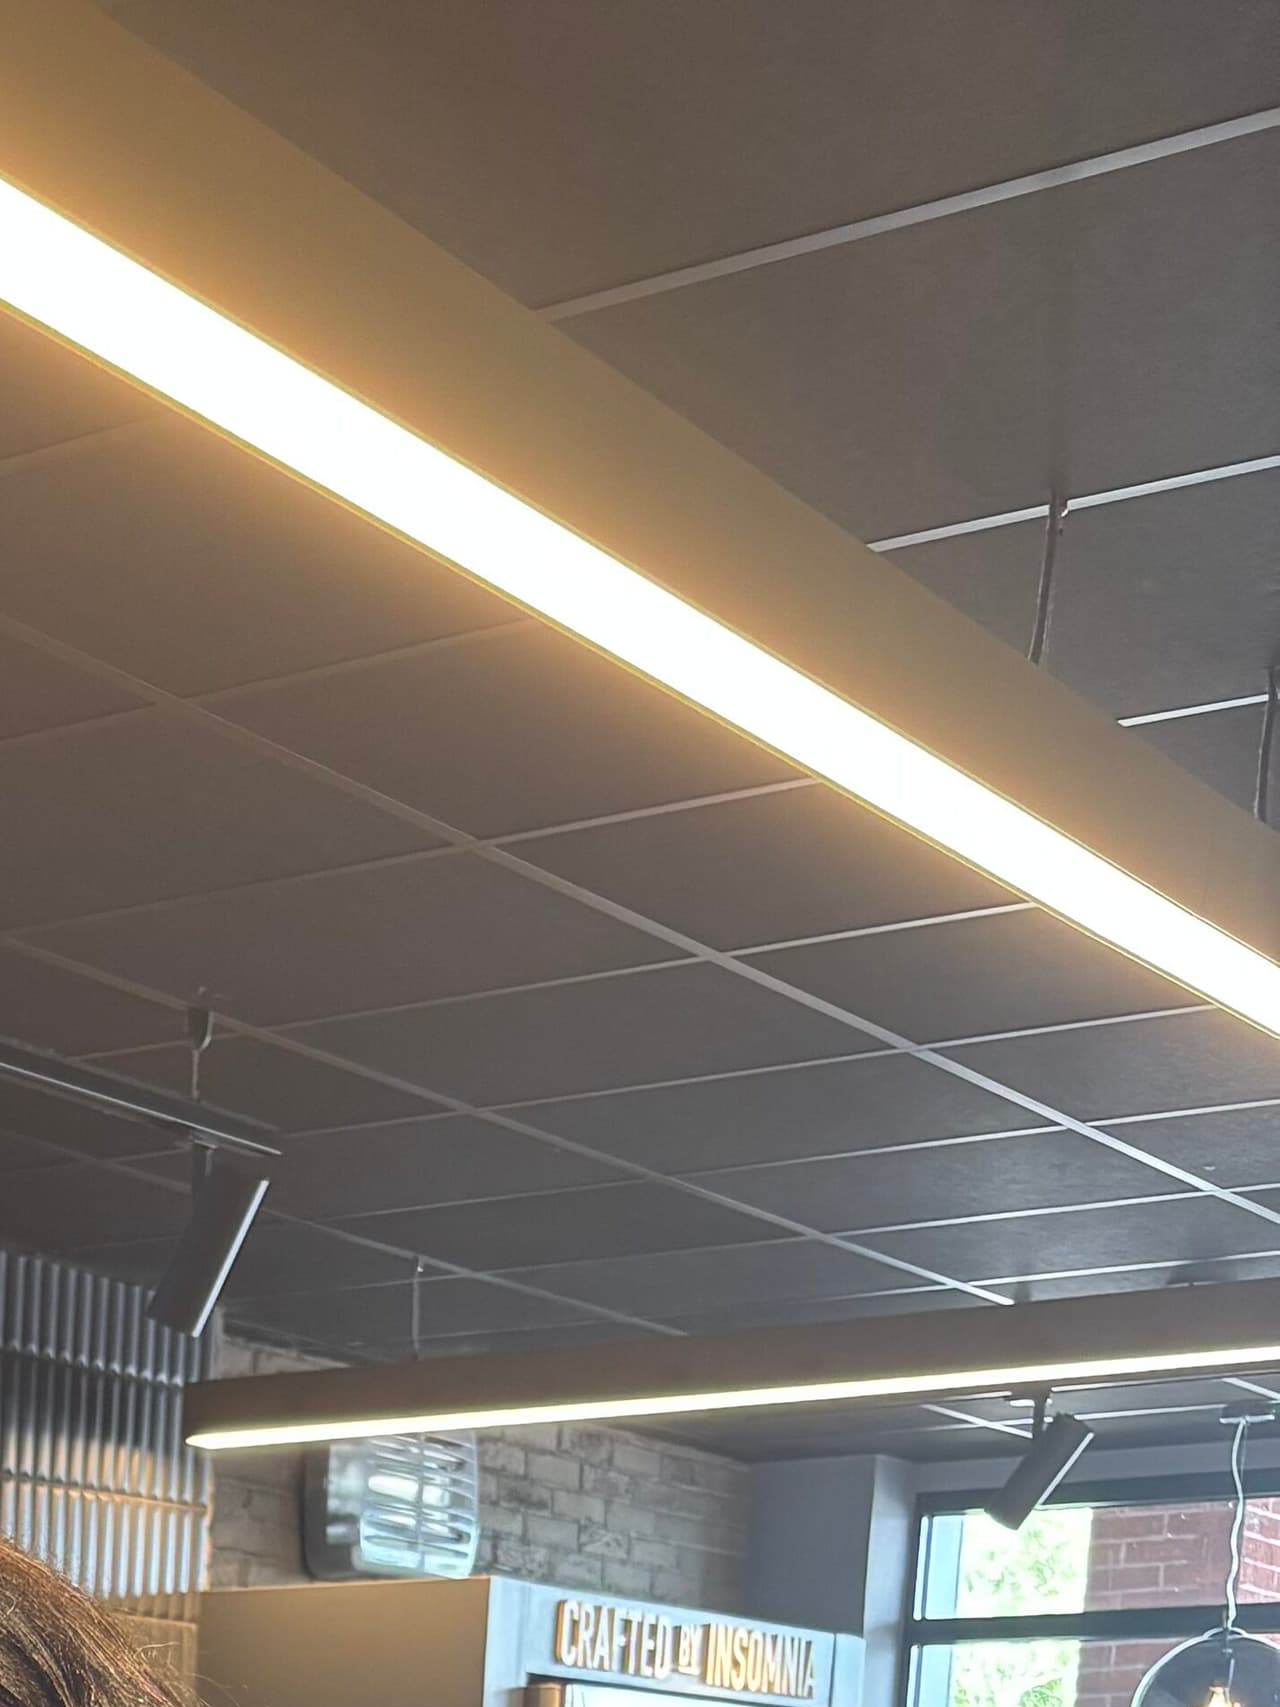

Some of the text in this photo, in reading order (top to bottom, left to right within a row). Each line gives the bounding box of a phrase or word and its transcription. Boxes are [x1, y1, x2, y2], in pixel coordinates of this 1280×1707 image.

[554, 1599, 817, 1699] CRAFTED BY INSOMNIA
